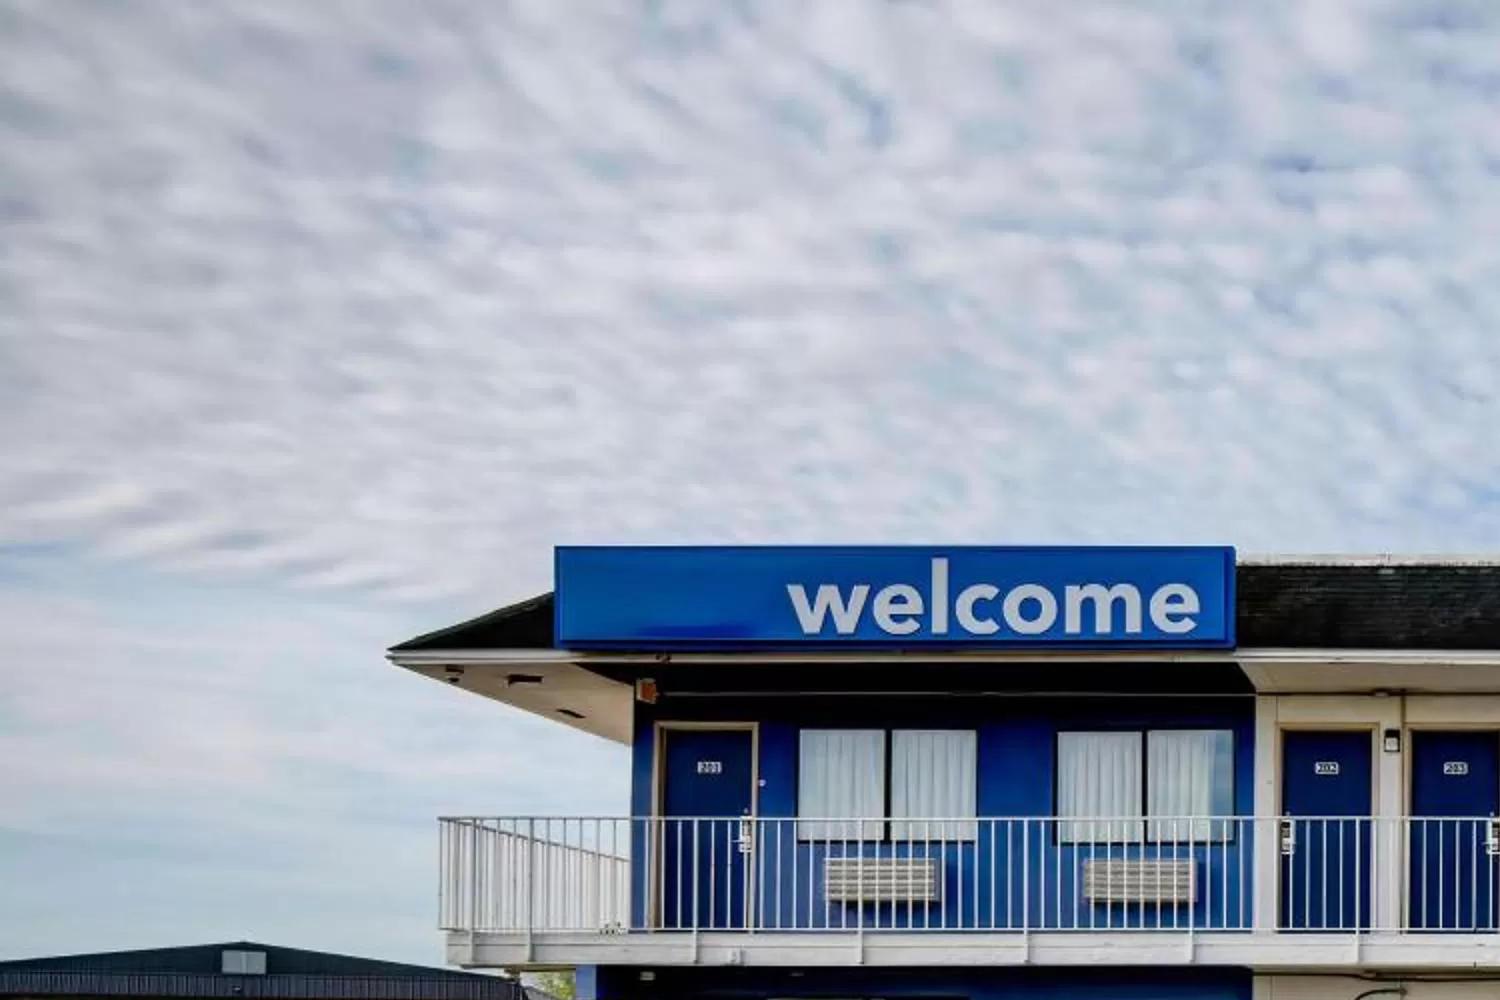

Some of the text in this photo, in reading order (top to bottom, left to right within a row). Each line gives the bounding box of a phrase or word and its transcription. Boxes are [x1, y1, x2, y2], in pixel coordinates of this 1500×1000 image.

[786, 557, 1200, 635] welcome
[700, 762, 719, 773] 201
[1317, 763, 1337, 773] 202
[1446, 763, 1465, 773] 203
